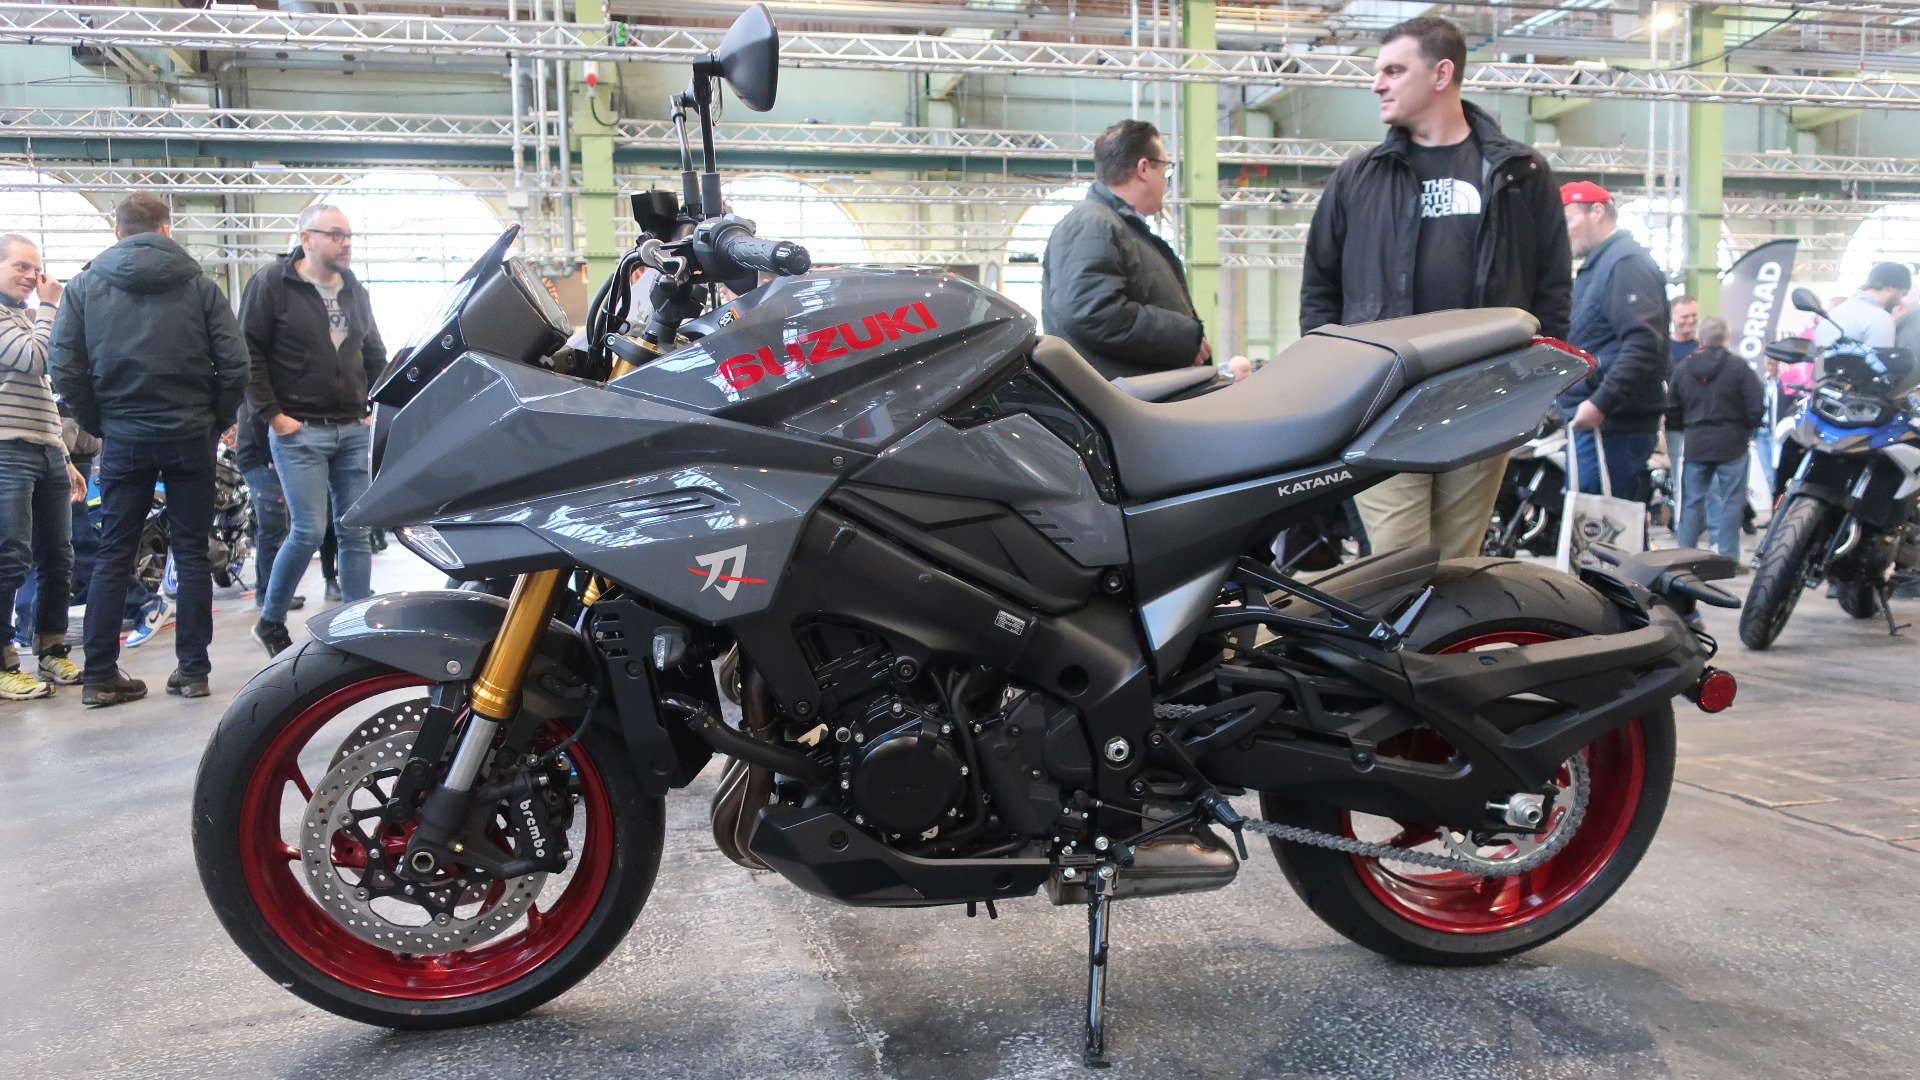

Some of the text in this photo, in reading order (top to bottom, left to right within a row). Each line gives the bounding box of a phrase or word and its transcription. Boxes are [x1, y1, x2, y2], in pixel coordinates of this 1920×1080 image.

[1420, 189, 1453, 206] RTH
[1421, 177, 1453, 193] THE
[1421, 202, 1453, 218] ACE
[1738, 261, 1782, 369] ORRAD
[715, 301, 938, 391] SUZUKI
[1277, 470, 1353, 497] KATANA
[519, 799, 546, 858] brembo
